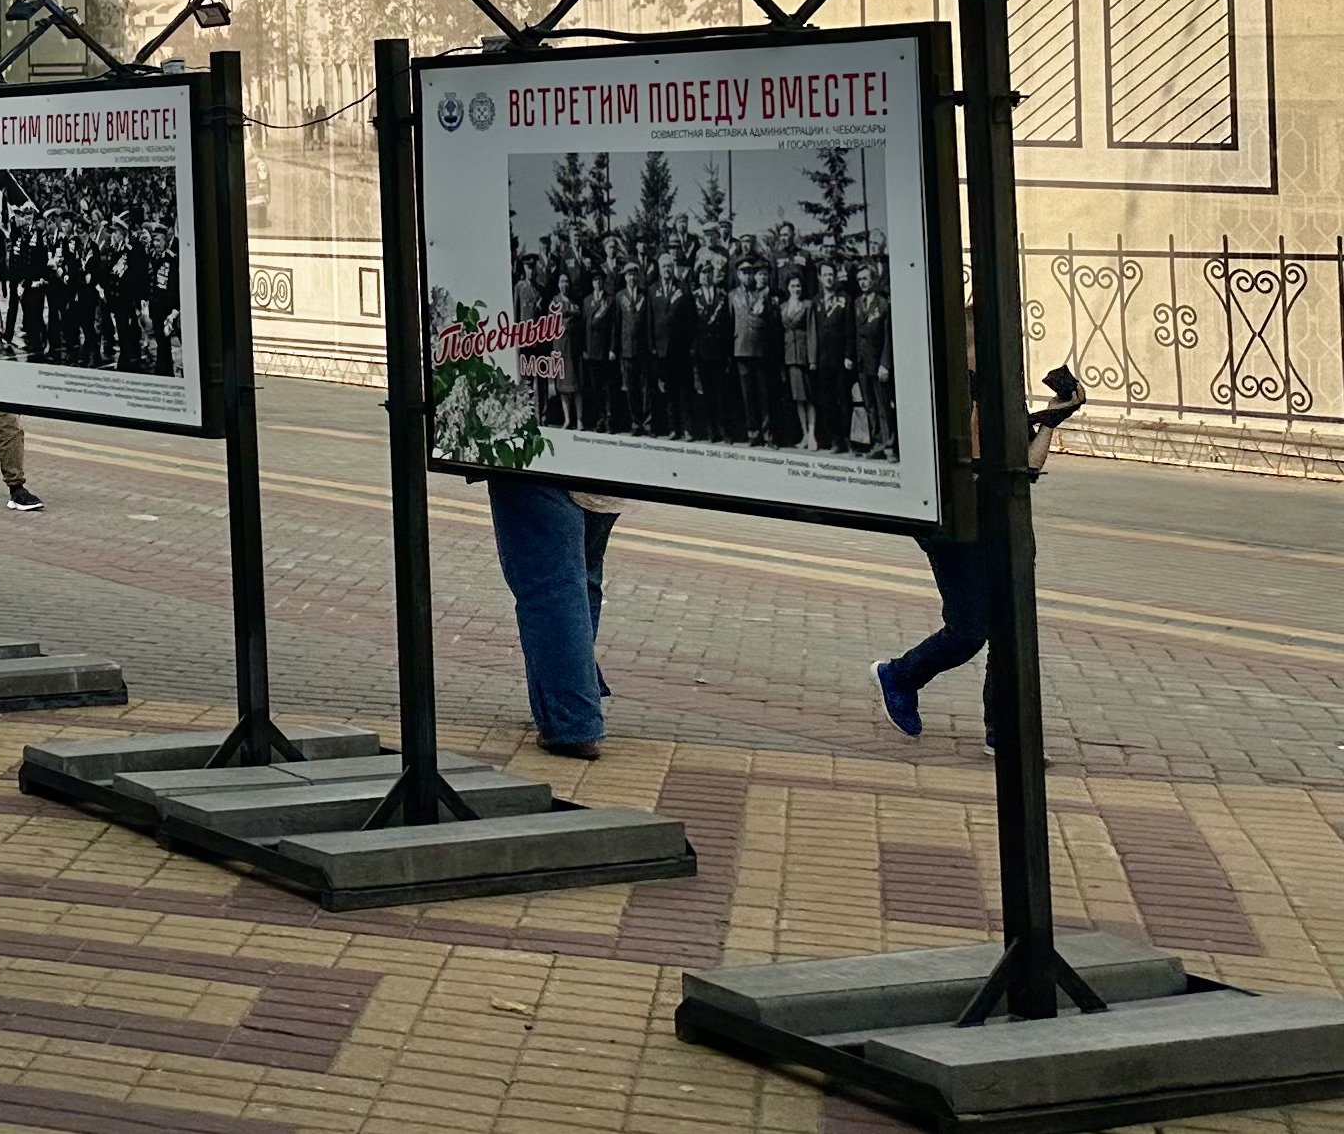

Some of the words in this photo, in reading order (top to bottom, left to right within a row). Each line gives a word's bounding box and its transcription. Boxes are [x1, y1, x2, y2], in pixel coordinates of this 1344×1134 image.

[508, 83, 639, 127] ВСТРЕТИМ
[648, 78, 750, 126] ПОБЕДУ
[761, 71, 888, 120] ВМЕСТЕ!
[46, 112, 101, 146] ПОБЕДУ
[106, 107, 177, 142] ВМЕСТЕ!
[651, 128, 704, 139] СОВМЕСТНАЯ
[705, 127, 748, 138] ВЫСТАВКА
[749, 125, 824, 138] АДМИНИСТРАЦИИ
[832, 124, 886, 135] ЧЕБОКСАРЫ
[433, 302, 564, 365] Победный
[519, 350, 565, 379] май
